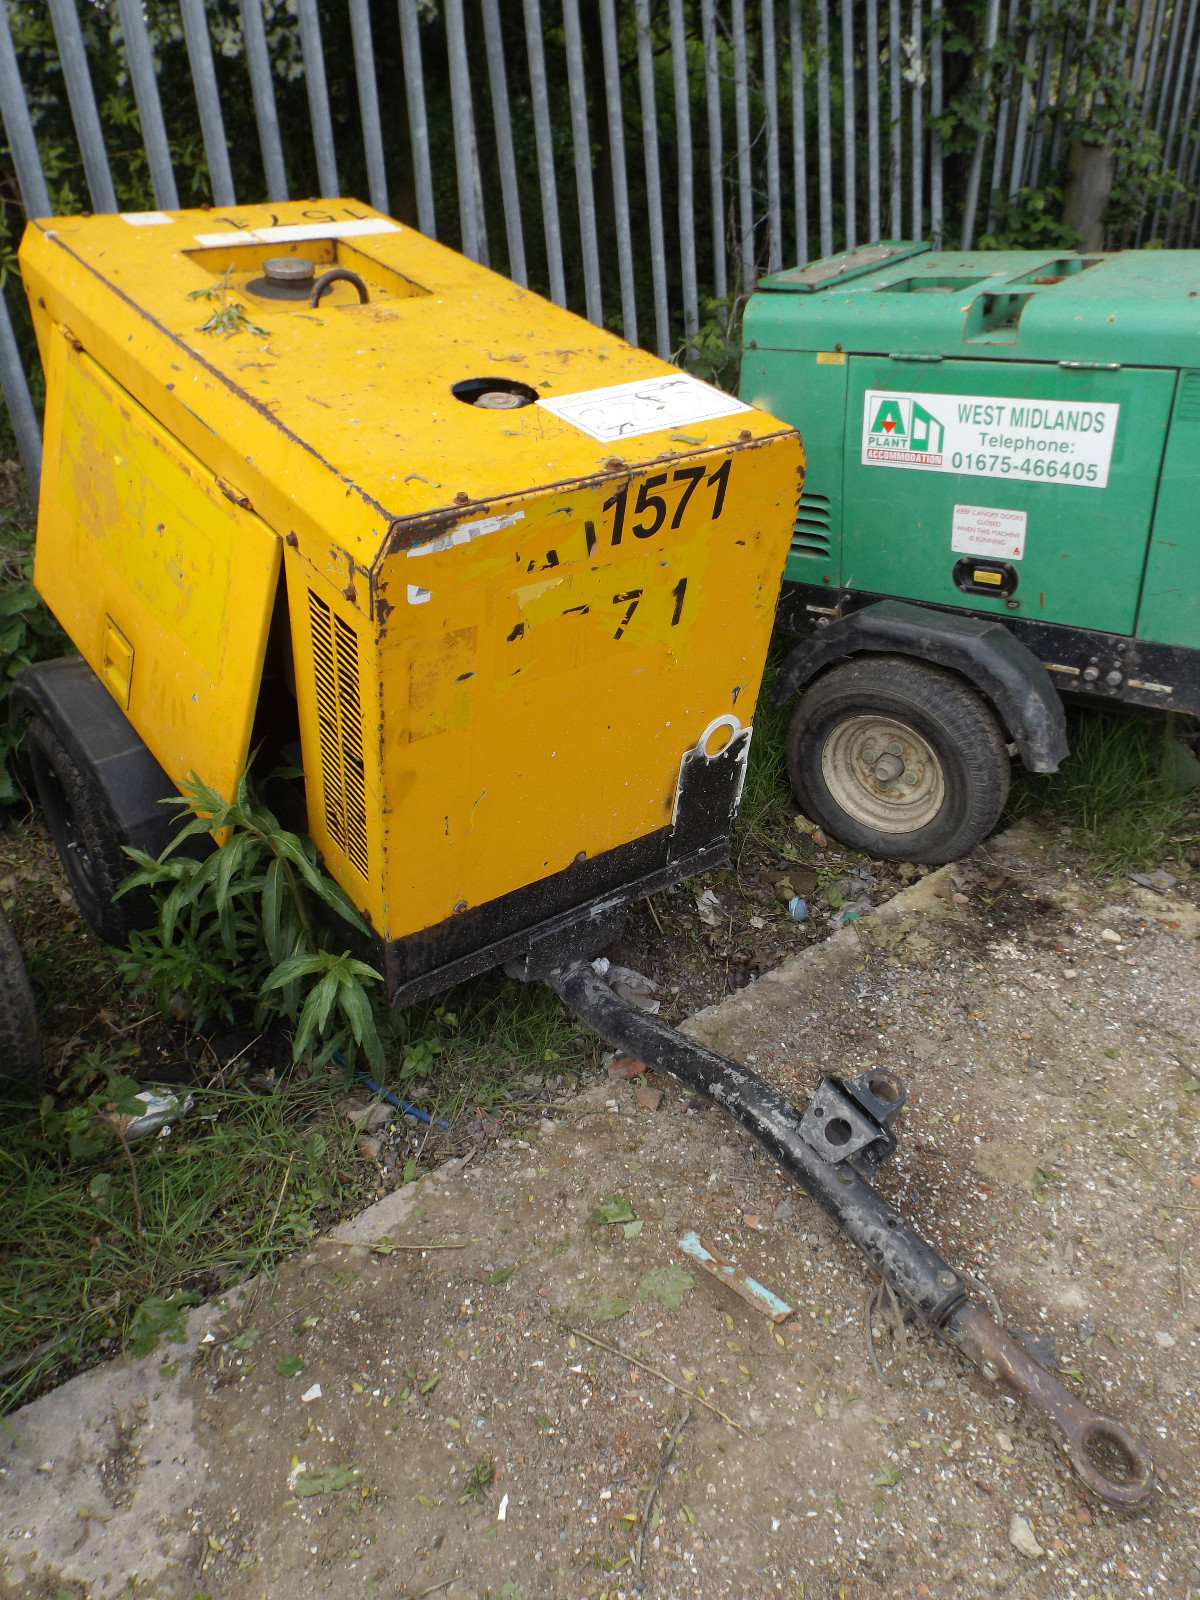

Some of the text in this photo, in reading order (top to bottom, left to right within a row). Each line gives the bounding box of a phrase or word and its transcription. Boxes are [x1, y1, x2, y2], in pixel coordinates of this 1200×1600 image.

[957, 404, 1106, 433] WEST MIDLANDS
[868, 436, 908, 449] PLANT
[979, 432, 1076, 454] Telephone:
[867, 449, 942, 465] ACCOMMODATION
[952, 452, 1098, 481] 01675-466405
[602, 459, 733, 546] 1571
[972, 510, 999, 518] CANOPY
[1000, 513, 1024, 521] DOORS
[976, 519, 1002, 527] CLOSED
[975, 536, 1006, 546] RUNNING
[992, 530, 1021, 539] MACHINE
